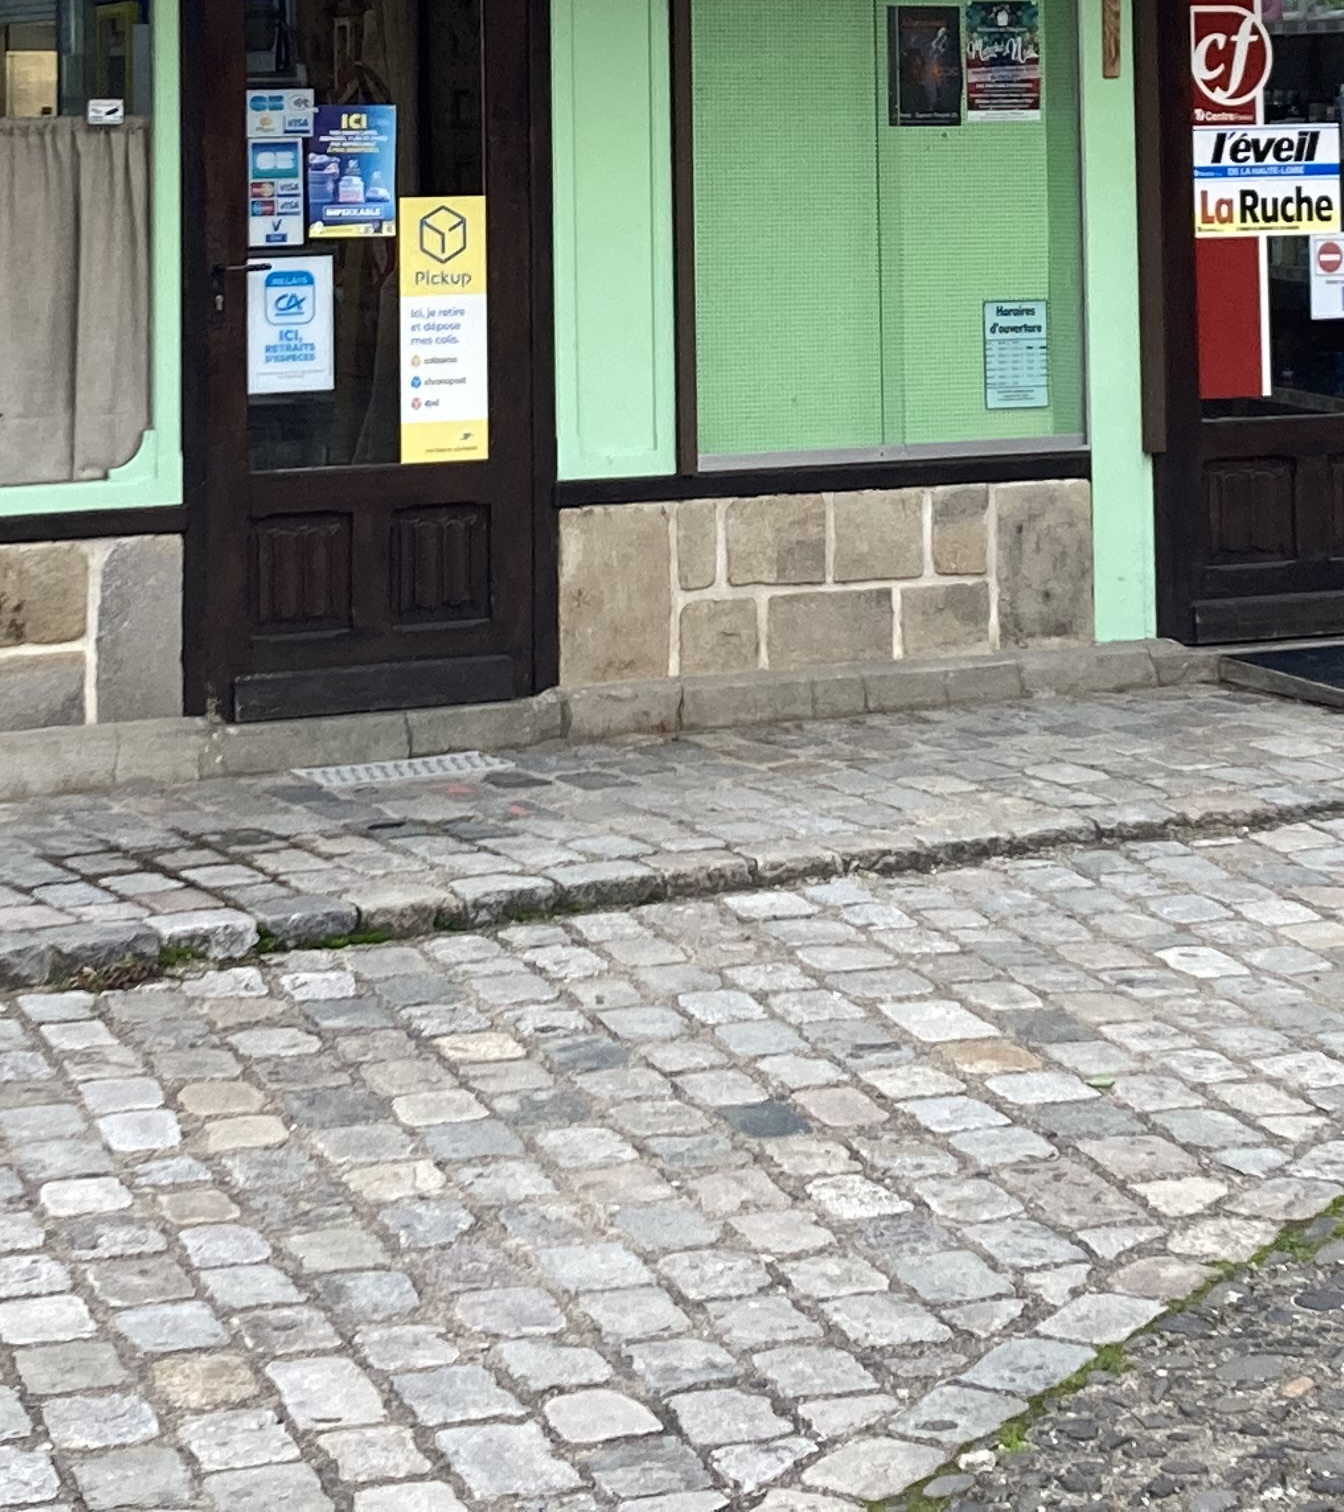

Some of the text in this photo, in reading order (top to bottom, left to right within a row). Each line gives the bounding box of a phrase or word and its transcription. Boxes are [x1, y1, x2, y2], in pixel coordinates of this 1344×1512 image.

[341, 113, 368, 129] ICI
[1211, 131, 1320, 163] l'éveil
[1200, 186, 1333, 224] La Ruche
[415, 271, 472, 287] Pickup
